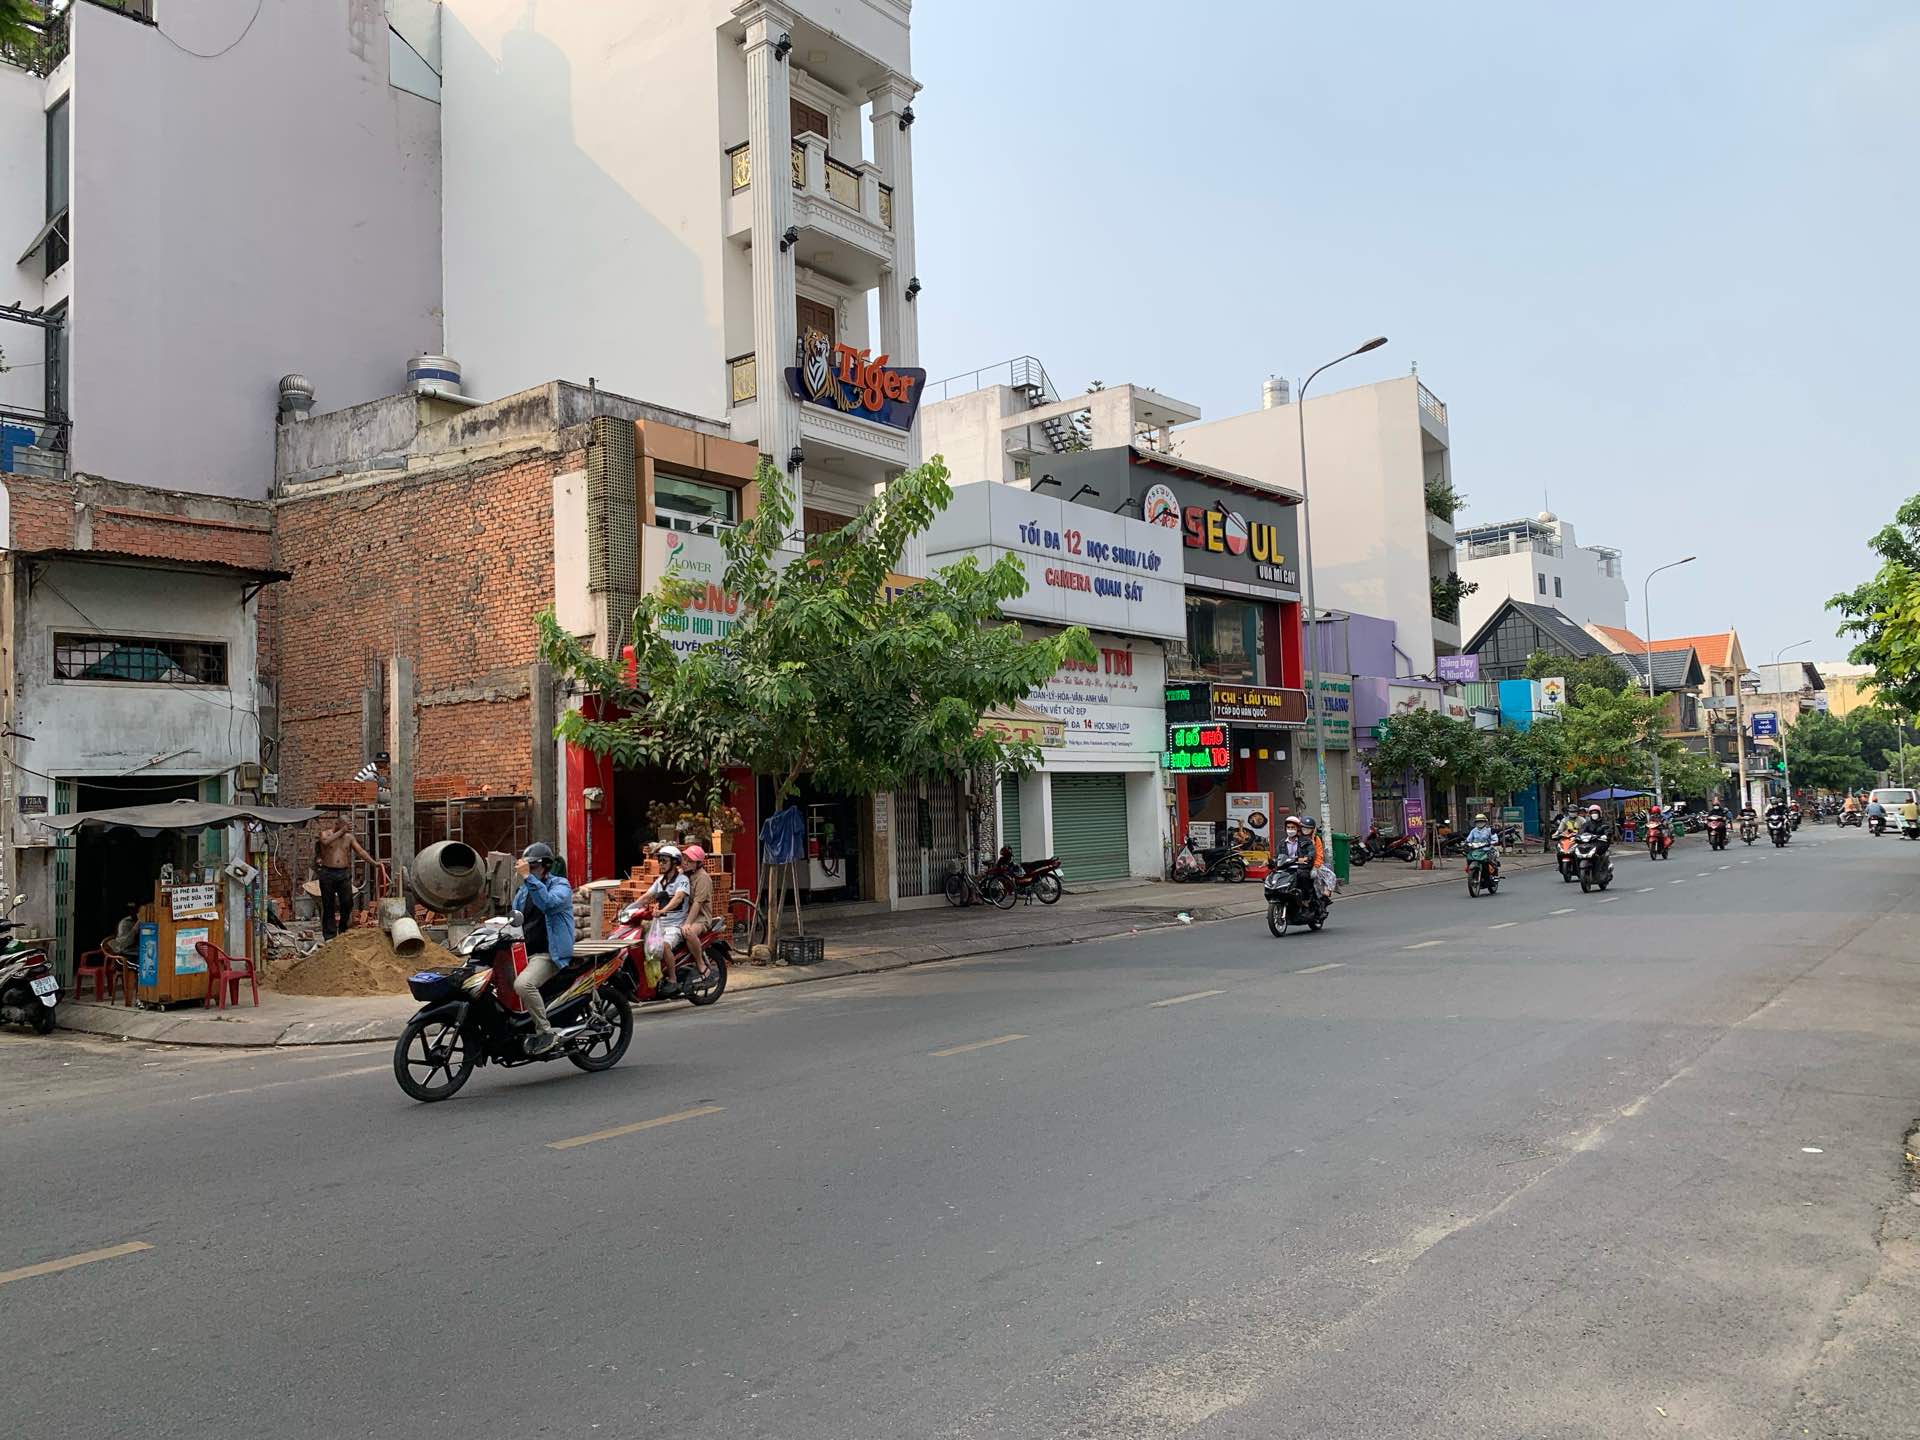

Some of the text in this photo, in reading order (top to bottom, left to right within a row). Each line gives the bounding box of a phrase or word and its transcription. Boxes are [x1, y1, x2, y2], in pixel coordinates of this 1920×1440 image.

[833, 342, 915, 411] Tiger
[1019, 520, 1162, 572] TỐI ĐA 12 HỌC SINH/LỚP
[1183, 500, 1286, 565] SEOUL
[1045, 568, 1144, 602] CAMERA QUAN SÁT
[692, 616, 713, 636] HOA
[1101, 643, 1133, 677] TRÍ
[1221, 694, 1236, 705] CHI
[1084, 719, 1093, 729] 14
[1185, 726, 1200, 746] SỐ
[1200, 725, 1224, 746] NHỎ
[1212, 747, 1228, 767] TO
